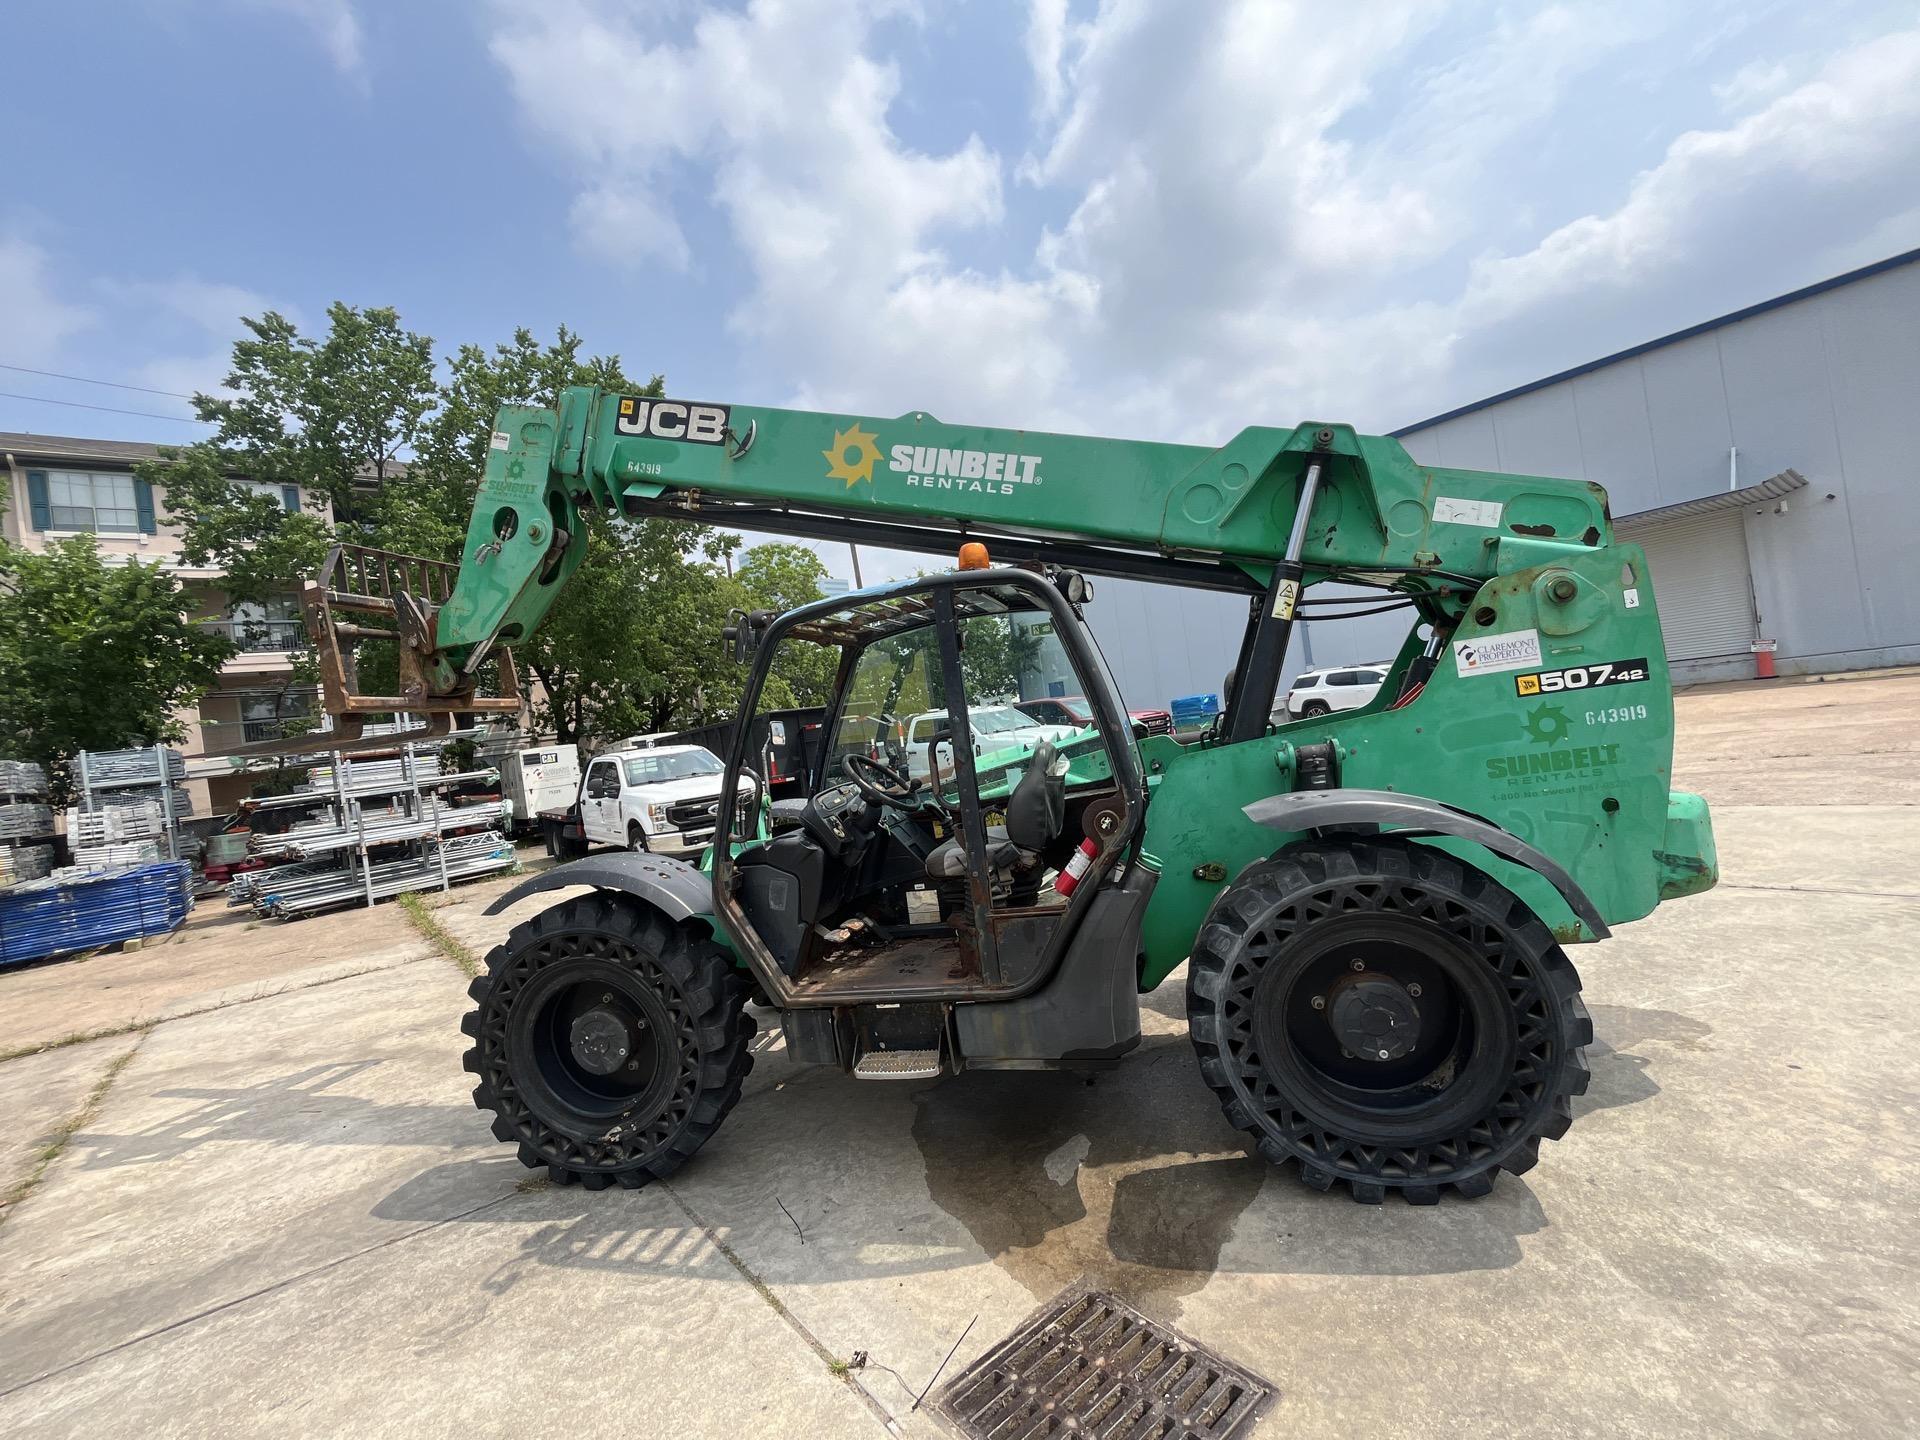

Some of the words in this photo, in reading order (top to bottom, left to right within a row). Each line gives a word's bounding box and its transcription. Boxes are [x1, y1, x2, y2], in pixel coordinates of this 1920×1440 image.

[619, 401, 726, 442] JCB
[627, 461, 661, 475] 643919
[889, 444, 1042, 484] SUNBELT
[907, 475, 1014, 495] RENTALS
[1477, 638, 1536, 654] CLAREMONT
[1479, 646, 1523, 662] PROPERTY
[1540, 664, 1644, 692] 507-42
[1585, 704, 1647, 726] 643919
[541, 754, 557, 764] CAT
[1486, 743, 1620, 779] SUNBELT
[1507, 768, 1604, 787] RENTALS
